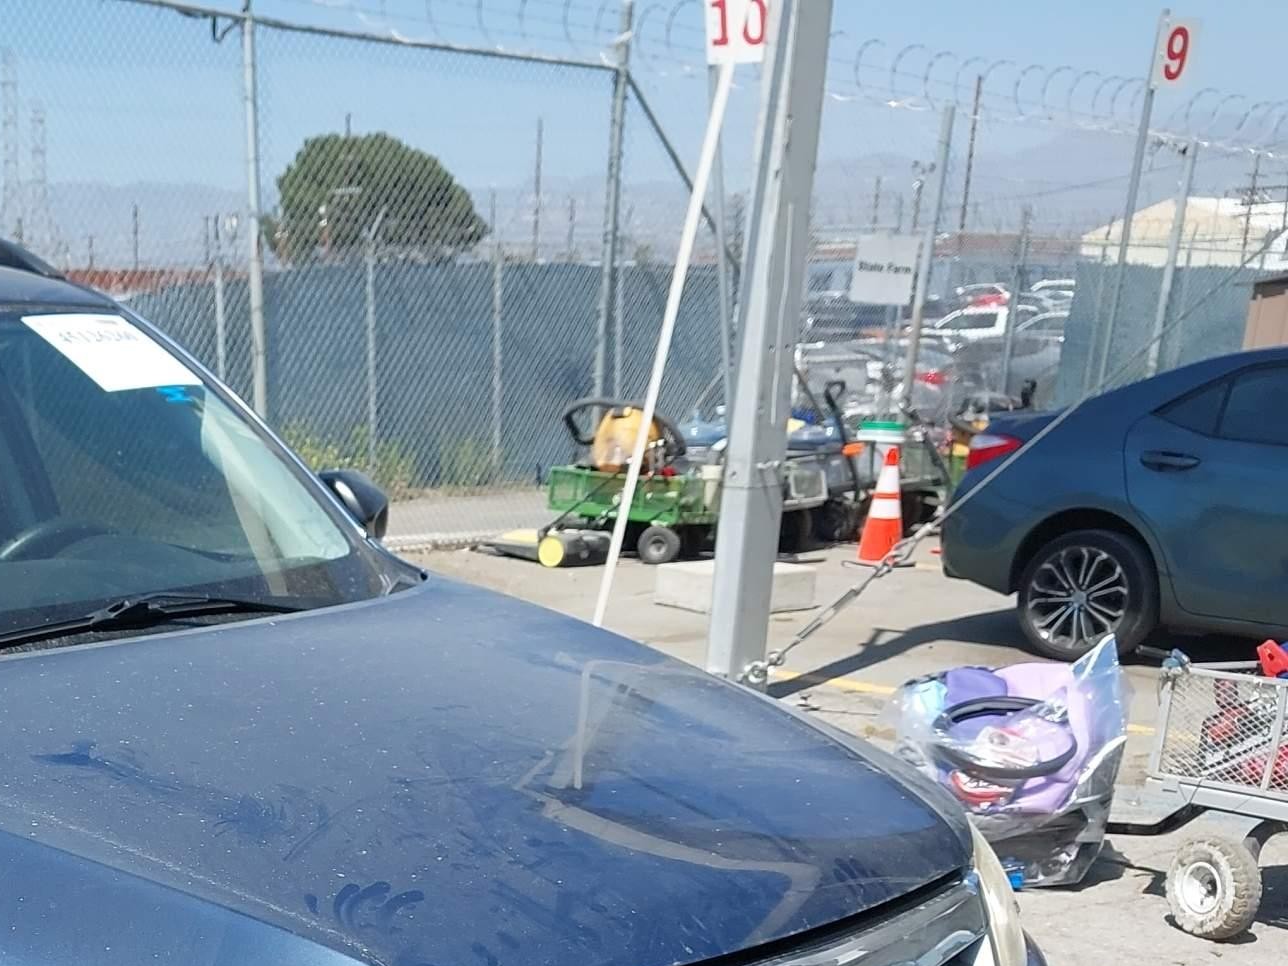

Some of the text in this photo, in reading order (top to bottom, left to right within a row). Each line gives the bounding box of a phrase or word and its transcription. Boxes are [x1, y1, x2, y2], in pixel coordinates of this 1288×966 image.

[711, 0, 767, 46] 10
[1164, 26, 1190, 81] 9
[857, 260, 912, 274] State Farm
